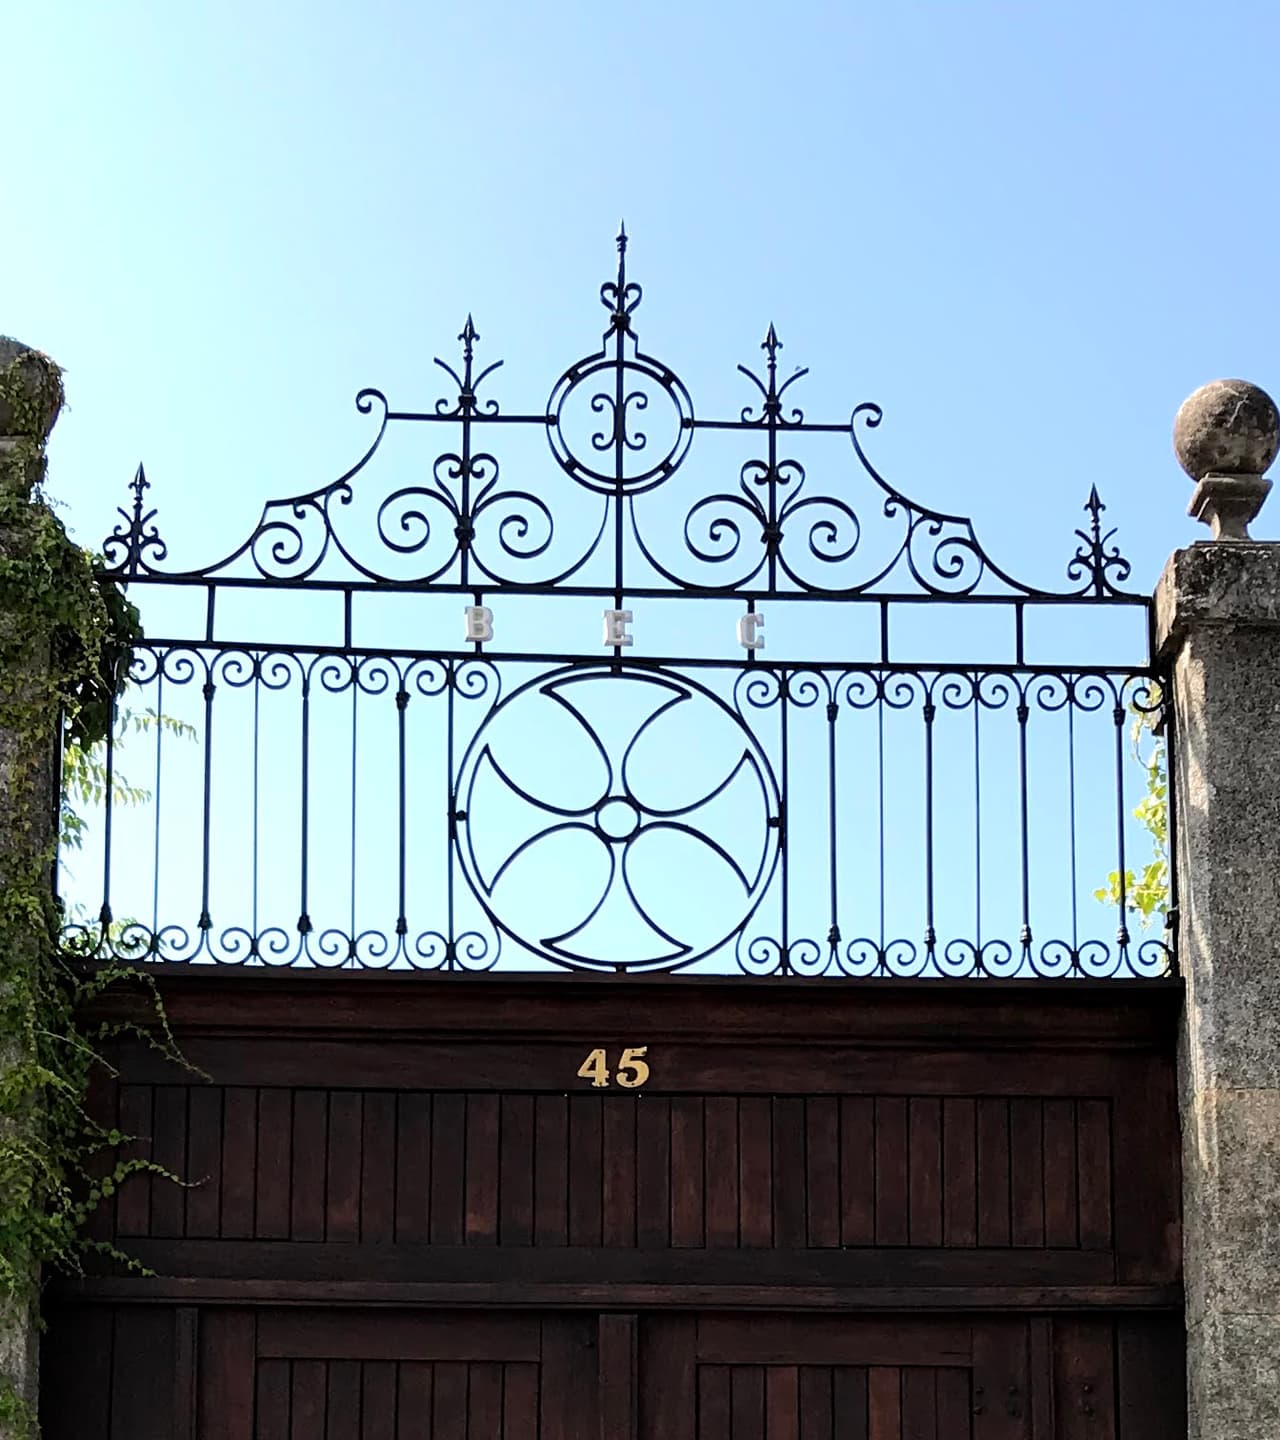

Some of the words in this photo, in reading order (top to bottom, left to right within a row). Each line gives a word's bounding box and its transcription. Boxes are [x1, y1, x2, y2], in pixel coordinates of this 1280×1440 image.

[465, 606, 494, 642] B
[604, 609, 634, 646] E
[736, 612, 765, 650] C
[577, 1046, 650, 1088] 45
